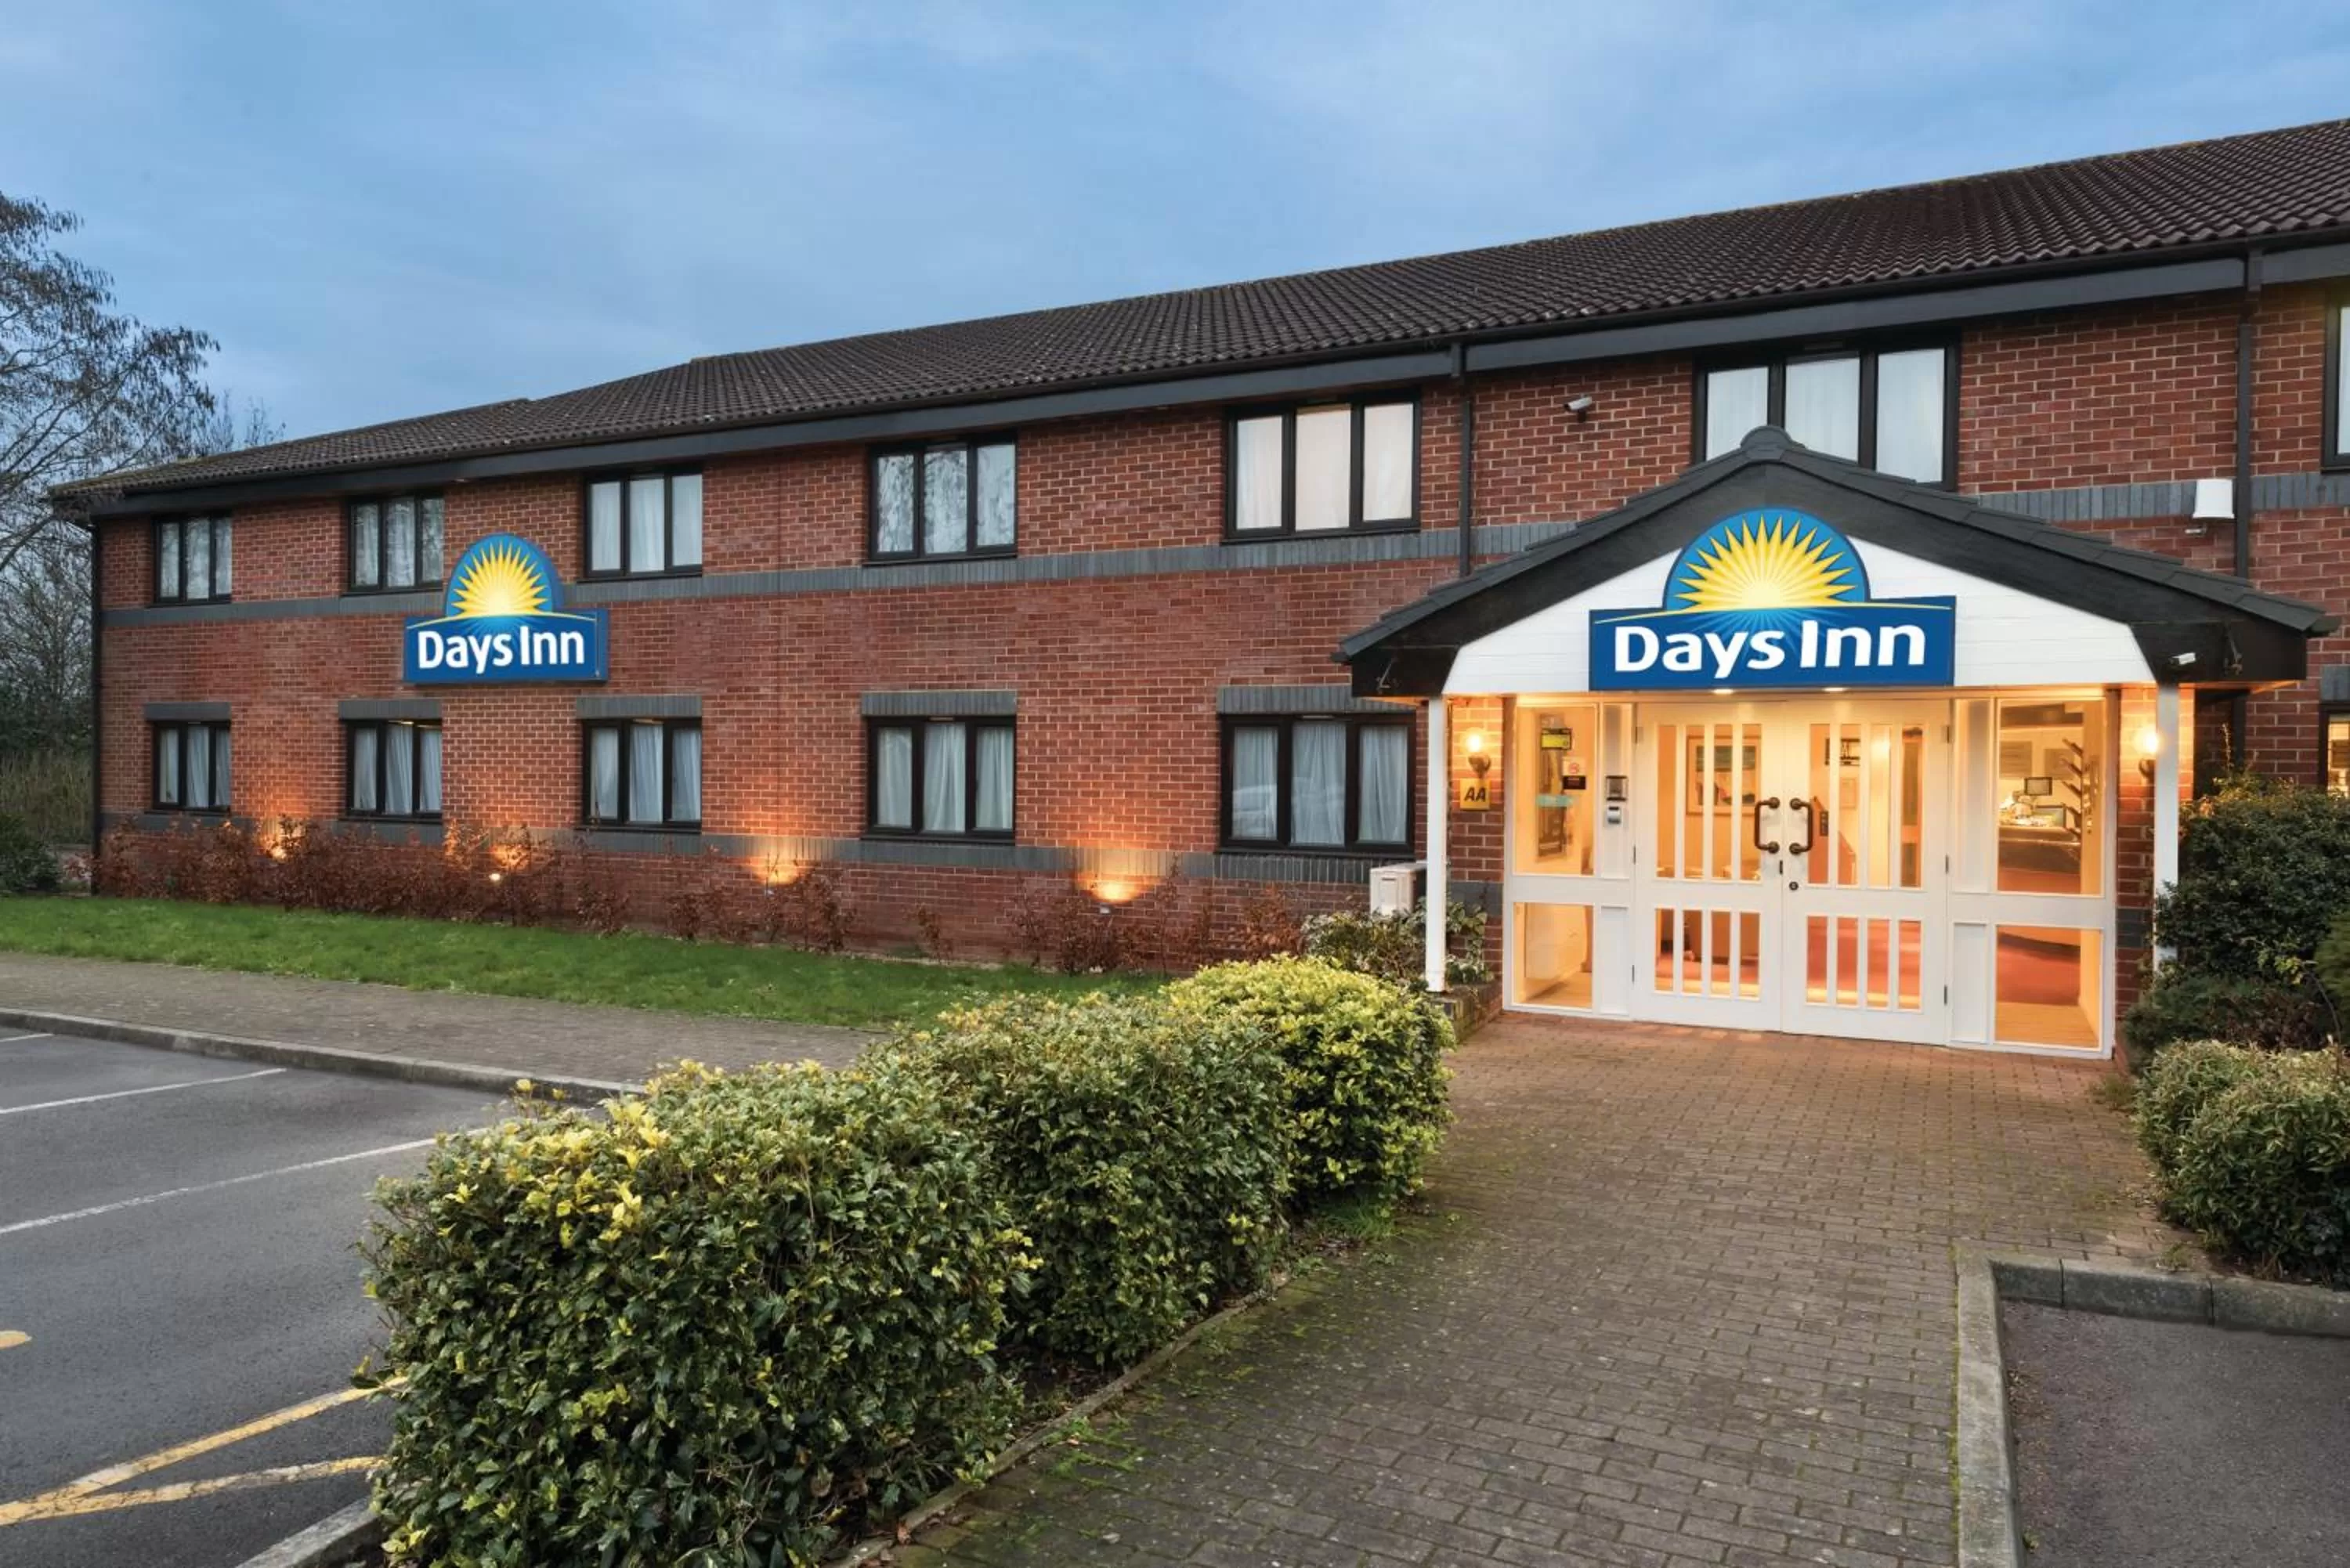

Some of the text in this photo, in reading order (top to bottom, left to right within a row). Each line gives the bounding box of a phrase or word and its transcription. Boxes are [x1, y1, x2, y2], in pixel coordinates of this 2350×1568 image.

[418, 626, 585, 674] Days Inn
[1614, 620, 1926, 679] Days Inn
[1463, 786, 1487, 803] AA
